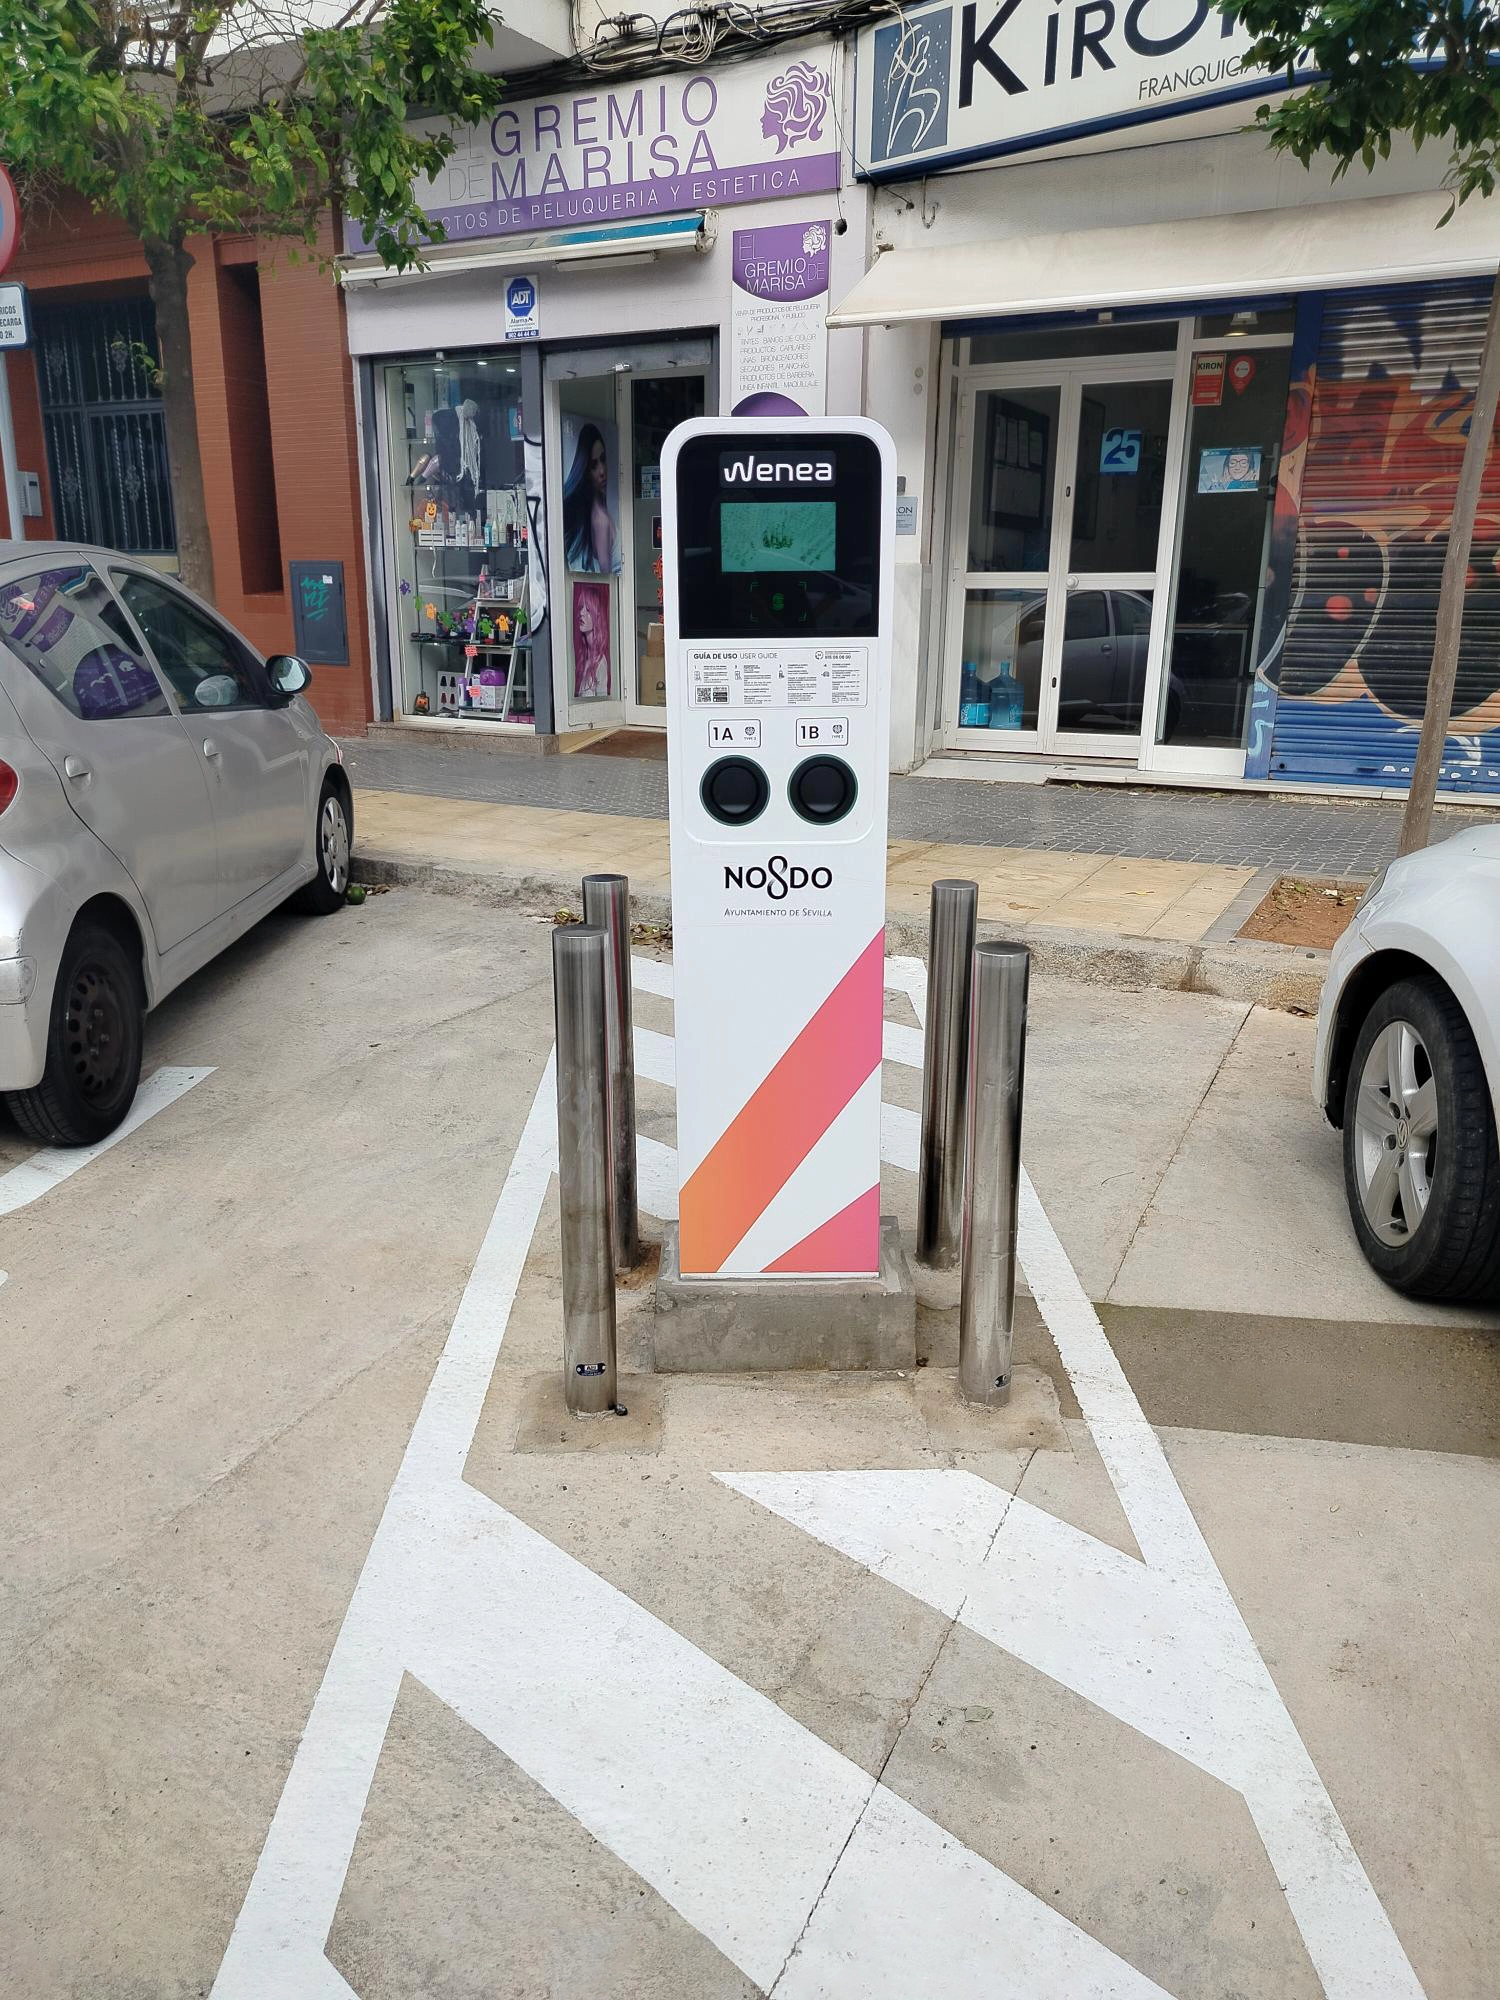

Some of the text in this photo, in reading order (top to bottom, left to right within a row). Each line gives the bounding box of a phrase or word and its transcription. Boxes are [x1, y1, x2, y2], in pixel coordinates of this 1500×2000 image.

[450, 76, 718, 161] EL GREMIO
[449, 130, 719, 200] DE MARISA
[498, 207, 521, 225] DE
[531, 189, 658, 221] PELUQUERIA
[670, 184, 680, 202] Y
[692, 169, 800, 199] ESTETICA
[740, 234, 765, 260] EL
[744, 257, 825, 281] GREMIO DE
[746, 274, 806, 294] MARISA
[512, 290, 531, 305] ADT
[756, 306, 785, 314] PRODUCTOS
[741, 337, 760, 346] TINTES
[794, 333, 817, 342] COLOR
[740, 343, 811, 355] PRODUCTOS CAPILARES
[760, 353, 809, 363] BRONCEADORES
[740, 361, 810, 373] SECADORES PLANCHAS
[1198, 362, 1223, 370] KIRON
[740, 370, 815, 382] PRODUCTOS DE BARBERIA
[724, 455, 832, 482] Wenea
[896, 506, 913, 514] ON
[693, 651, 711, 660] GUÍA
[739, 652, 757, 660] USER
[713, 726, 734, 741] 1A
[800, 725, 820, 740] 1B
[724, 907, 787, 917] AYUNTAMIENTO
[802, 907, 833, 918] SEVILLA
